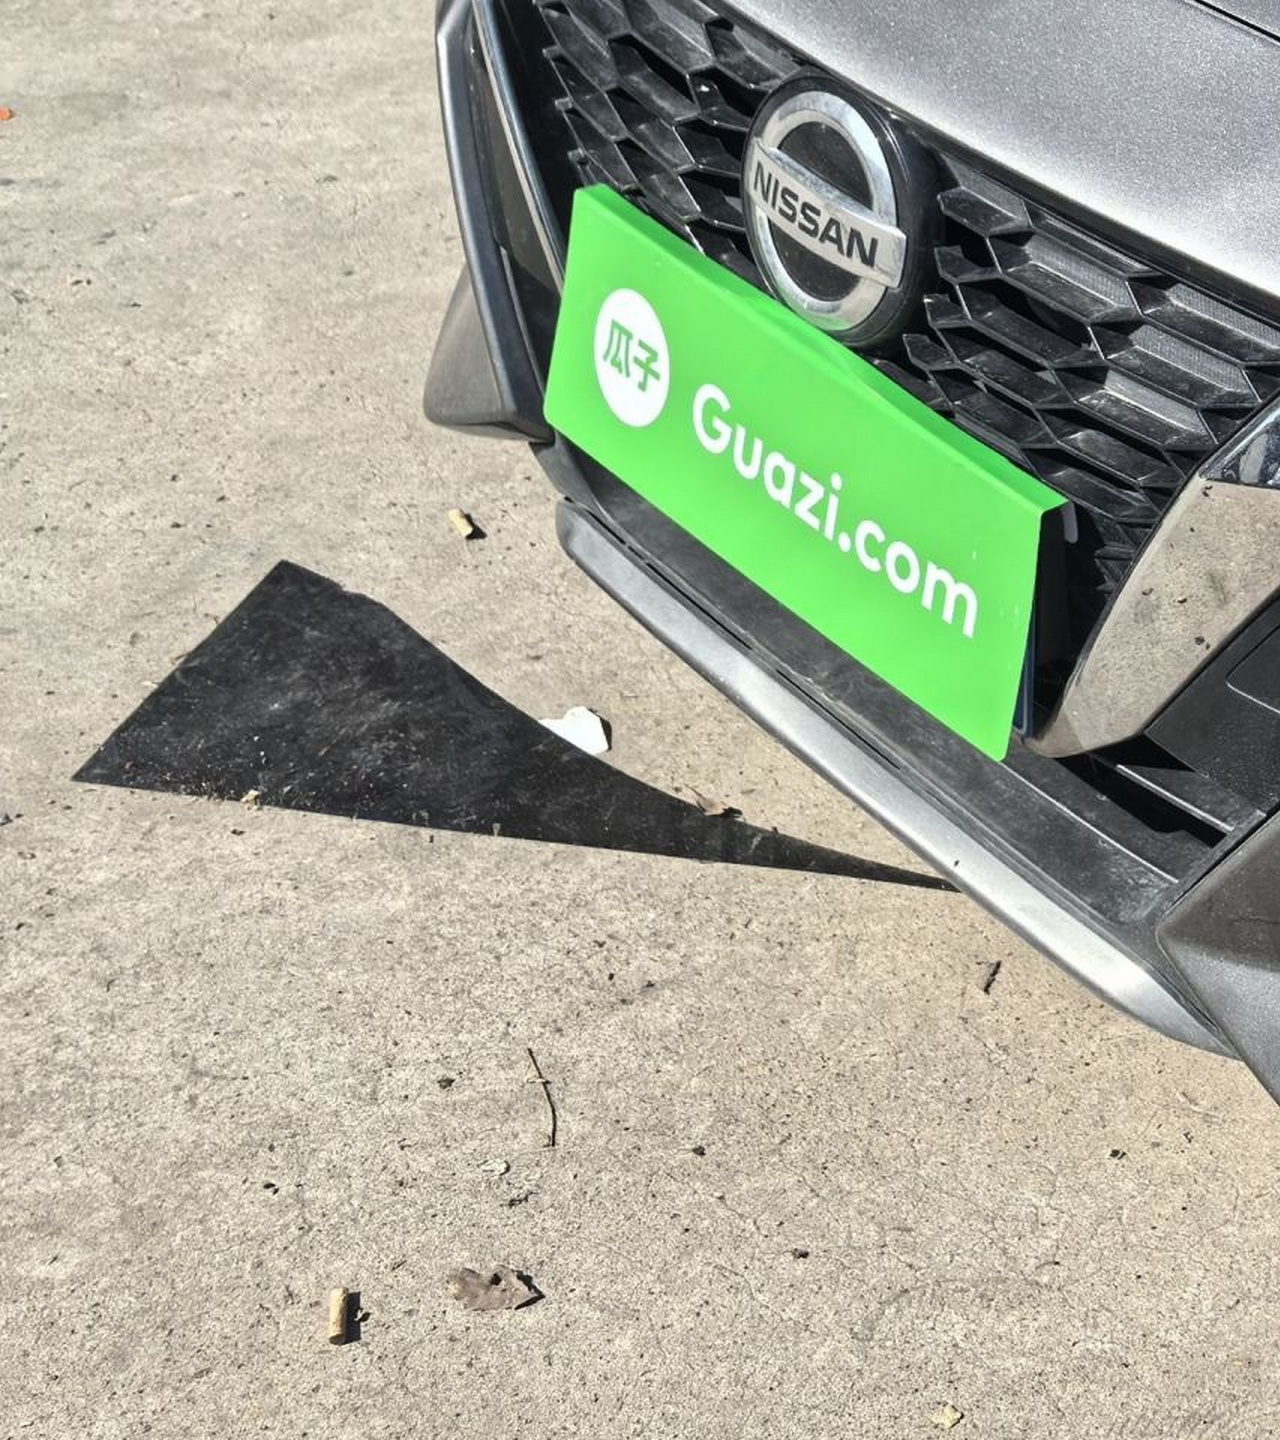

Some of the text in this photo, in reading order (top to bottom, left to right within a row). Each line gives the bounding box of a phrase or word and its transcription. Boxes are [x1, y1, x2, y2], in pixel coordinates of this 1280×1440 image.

[754, 161, 878, 268] NISSAN
[603, 319, 660, 392] 瓜子
[692, 383, 978, 639] Guazi.com
